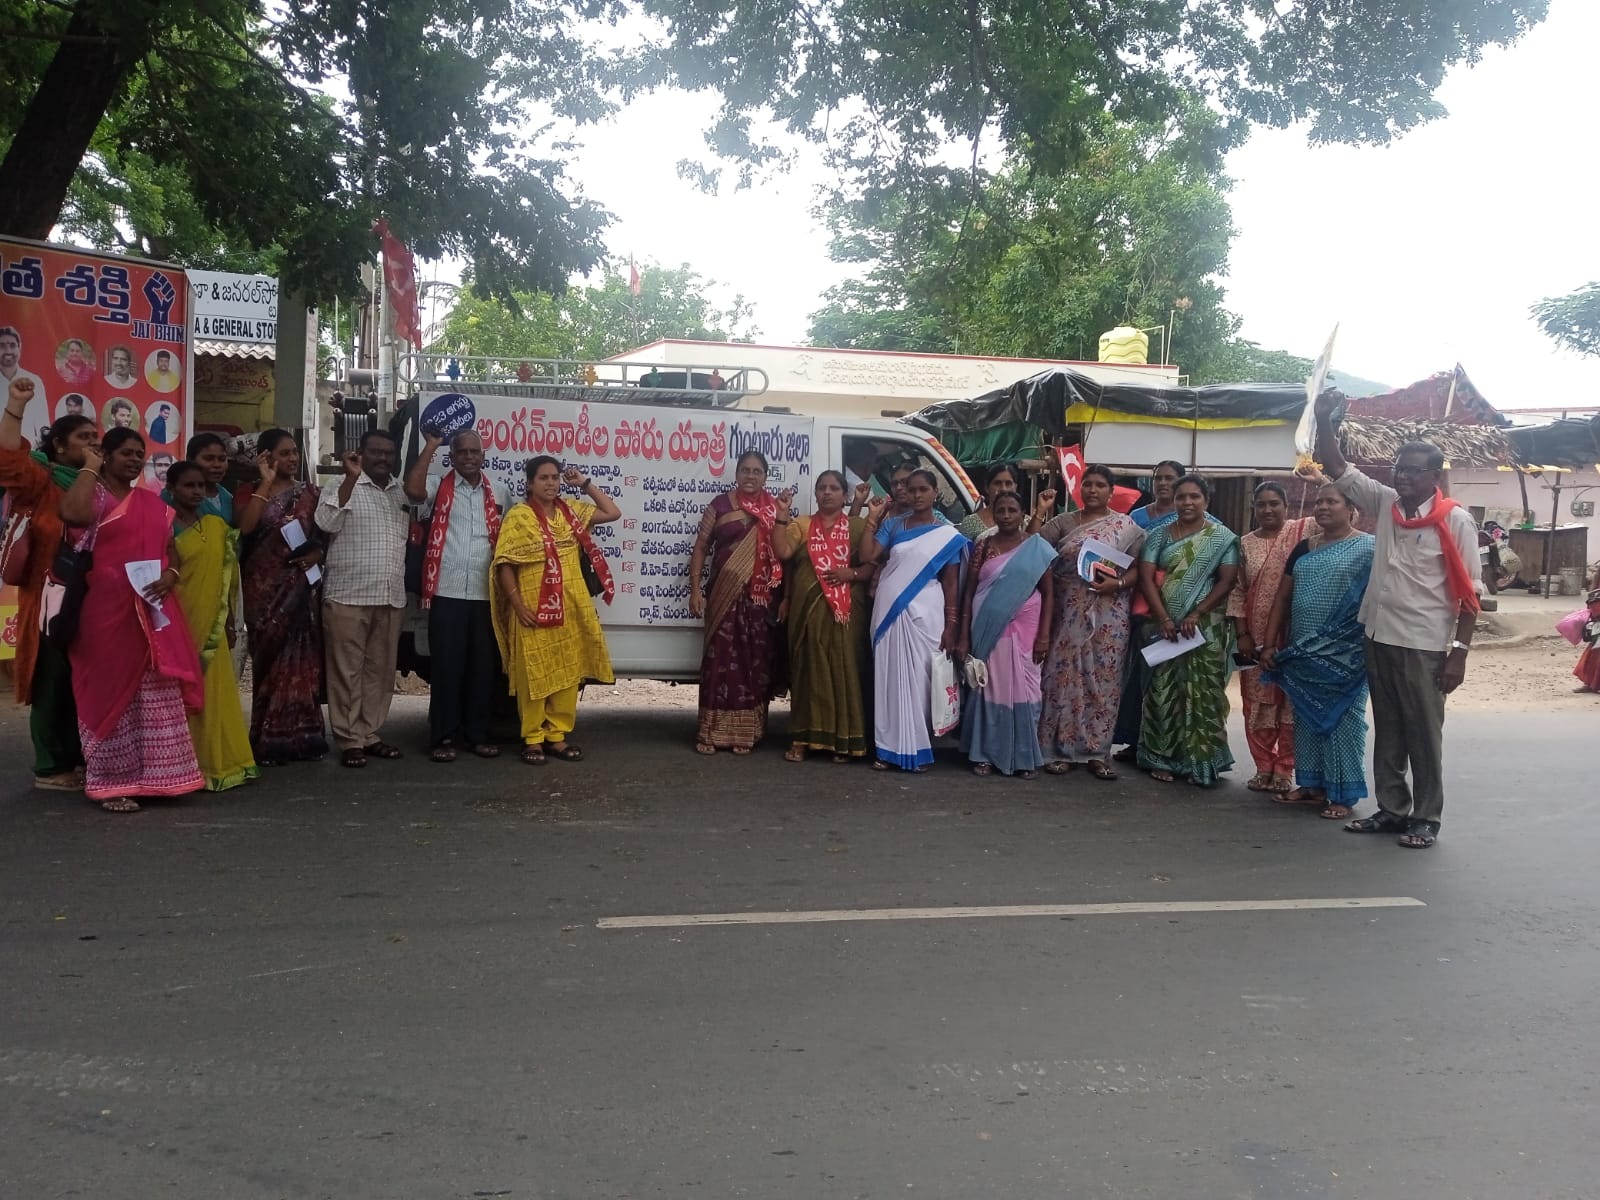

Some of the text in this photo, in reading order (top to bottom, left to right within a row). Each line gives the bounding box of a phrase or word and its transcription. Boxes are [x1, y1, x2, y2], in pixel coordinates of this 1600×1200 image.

[55, 264, 131, 325] శక్తి
[211, 282, 220, 300] &
[131, 320, 152, 340] JAI
[203, 317, 210, 335] &
[212, 318, 254, 338] GENERAL
[613, 417, 665, 463] పోరు
[668, 419, 727, 479] యాత్ర
[537, 611, 563, 621] CITU
